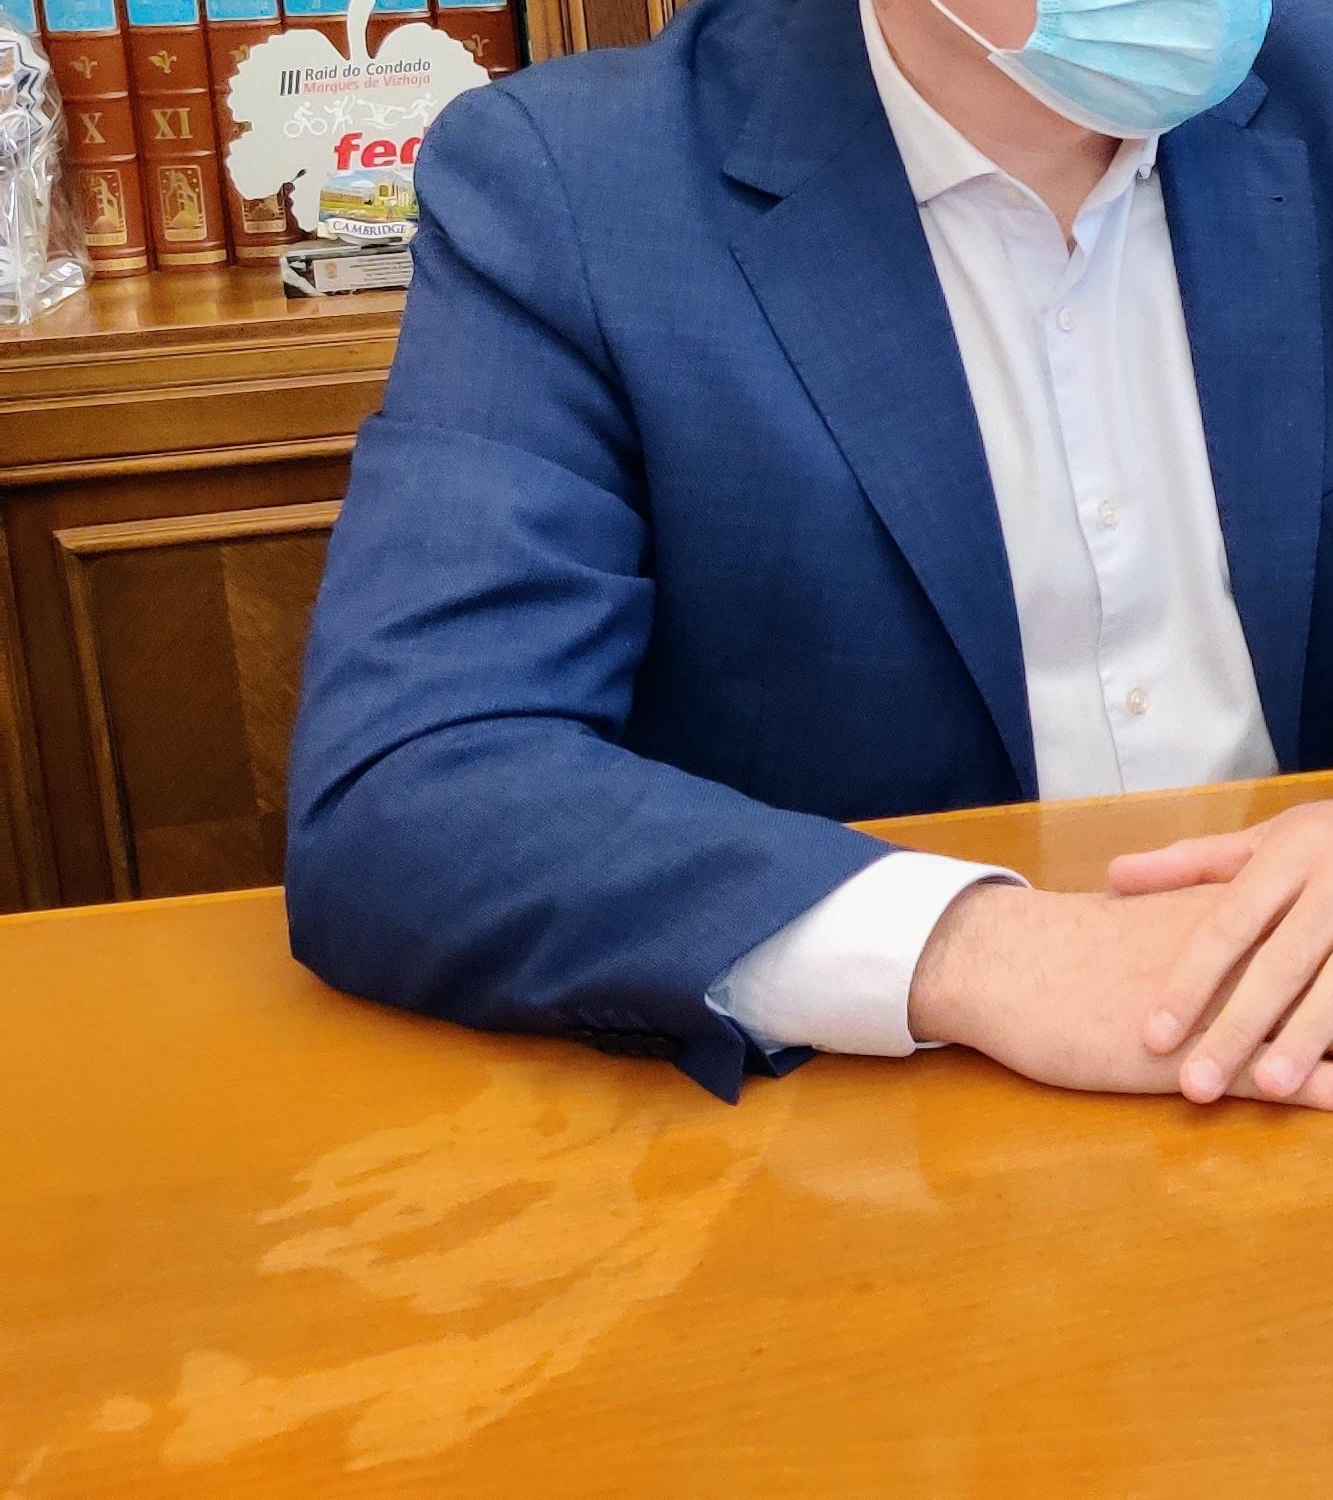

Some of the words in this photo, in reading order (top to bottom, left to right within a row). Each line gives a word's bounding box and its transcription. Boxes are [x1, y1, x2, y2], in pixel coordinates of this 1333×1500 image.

[280, 69, 302, 96] III
[304, 64, 338, 82] Raid
[341, 64, 361, 78] do
[365, 57, 431, 77] Condado
[363, 75, 381, 89] de
[383, 72, 431, 88] Vizhoja
[79, 111, 107, 145] X
[150, 106, 194, 141] XI
[331, 218, 407, 237] CAMBRIDGE
